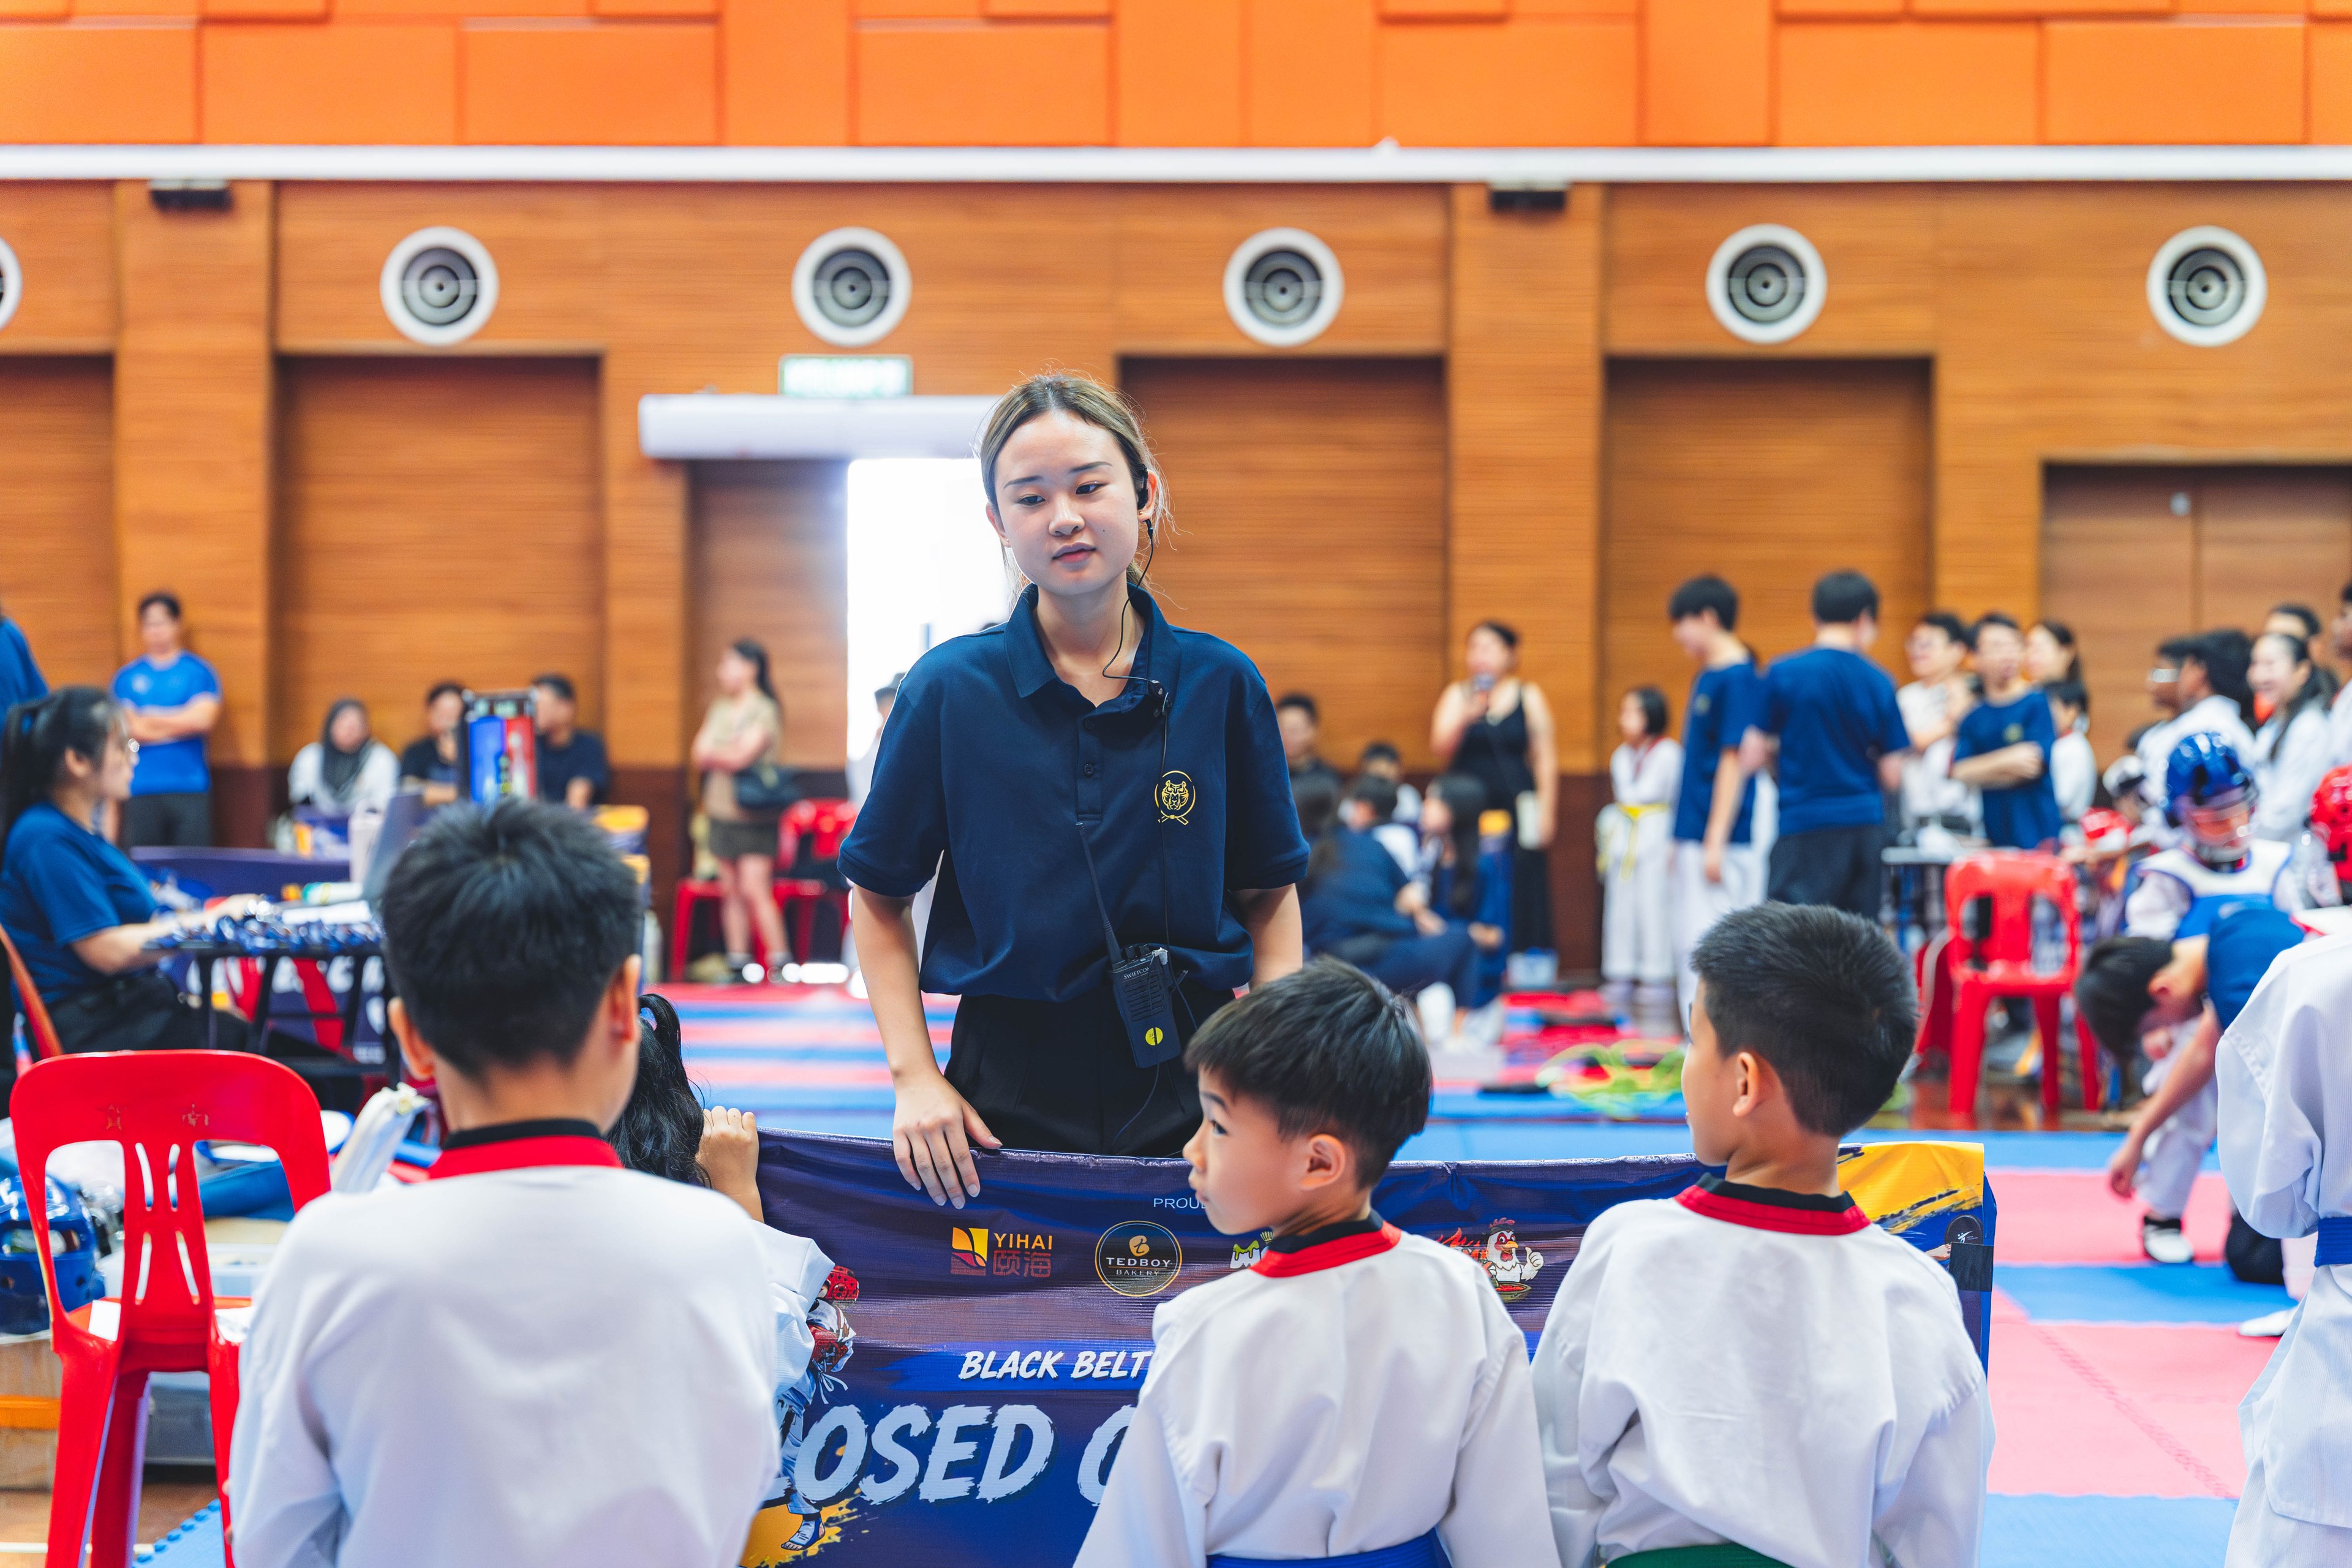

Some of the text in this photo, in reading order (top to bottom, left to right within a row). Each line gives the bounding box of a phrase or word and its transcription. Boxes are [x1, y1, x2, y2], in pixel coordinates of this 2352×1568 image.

[993, 1232, 1052, 1250] YIHAI
[1106, 1257, 1170, 1267] TEDBOY
[958, 1349, 1153, 1379] BLACK BELT
